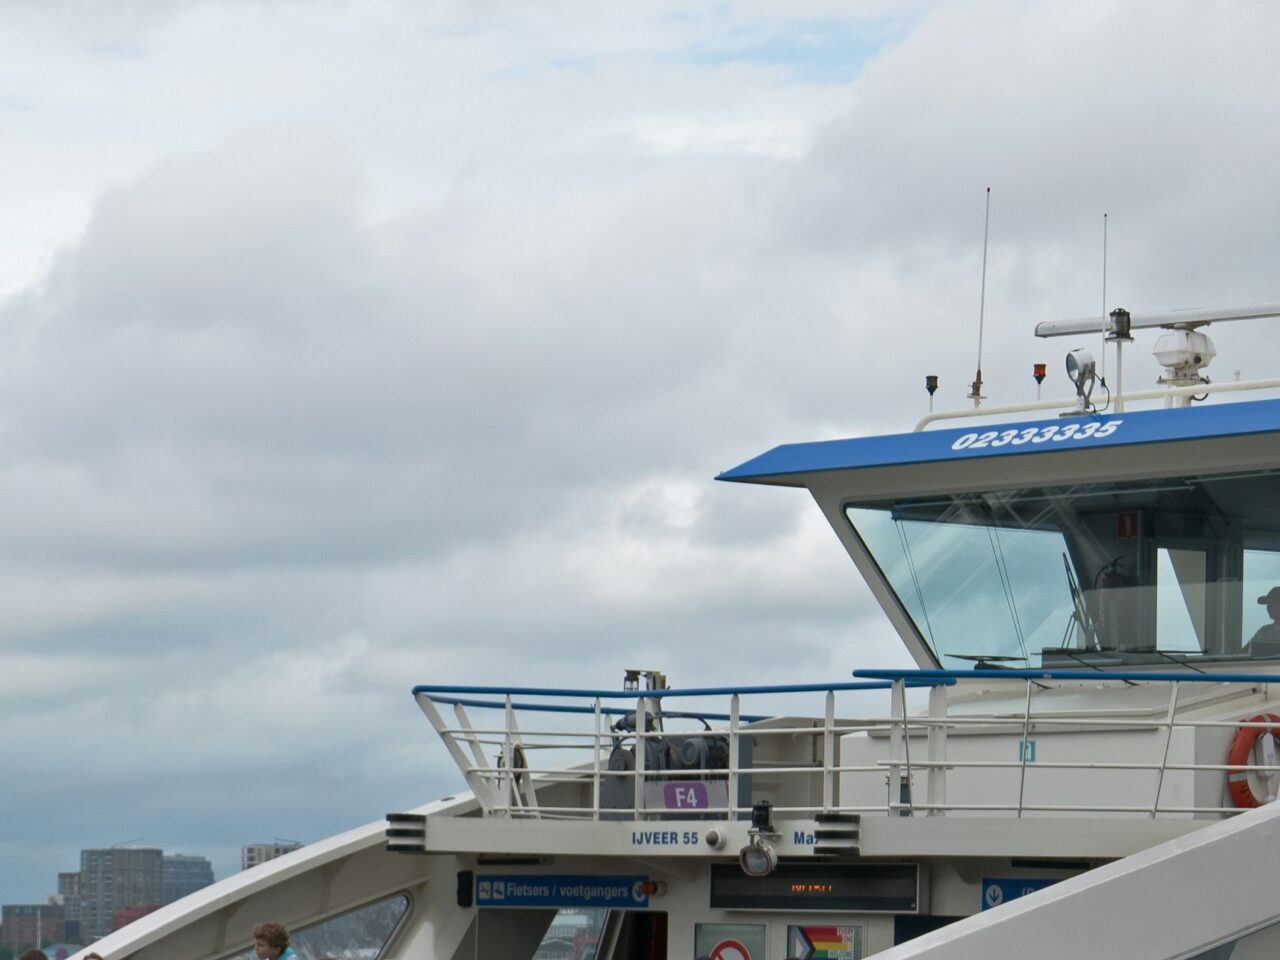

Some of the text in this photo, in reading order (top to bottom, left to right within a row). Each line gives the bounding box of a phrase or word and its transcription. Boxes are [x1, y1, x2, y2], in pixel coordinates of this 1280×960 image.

[951, 420, 1123, 450] 02333335
[675, 788, 698, 808] F4
[632, 832, 699, 845] IJVEER 55
[506, 883, 550, 896] Fietsers
[560, 883, 629, 899] voetgangers
